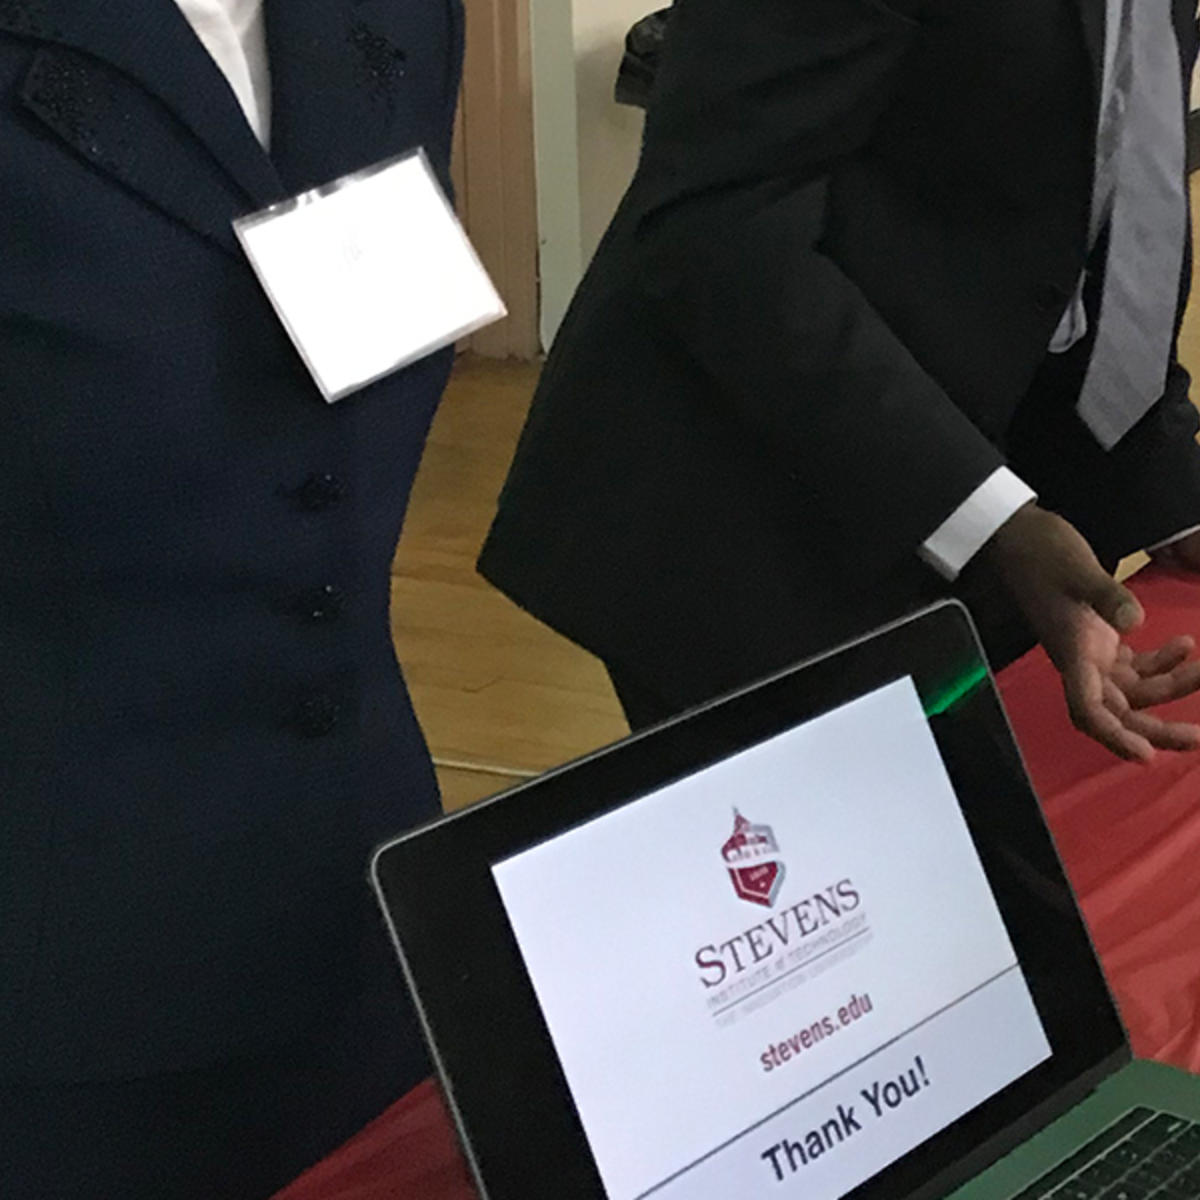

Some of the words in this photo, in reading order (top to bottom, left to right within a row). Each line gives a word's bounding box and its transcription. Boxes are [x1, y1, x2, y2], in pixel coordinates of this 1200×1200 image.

[695, 878, 860, 988] STEVENS
[760, 993, 873, 1072] stevens.edu
[761, 1104, 862, 1181] Thank
[860, 1055, 930, 1117] You!
